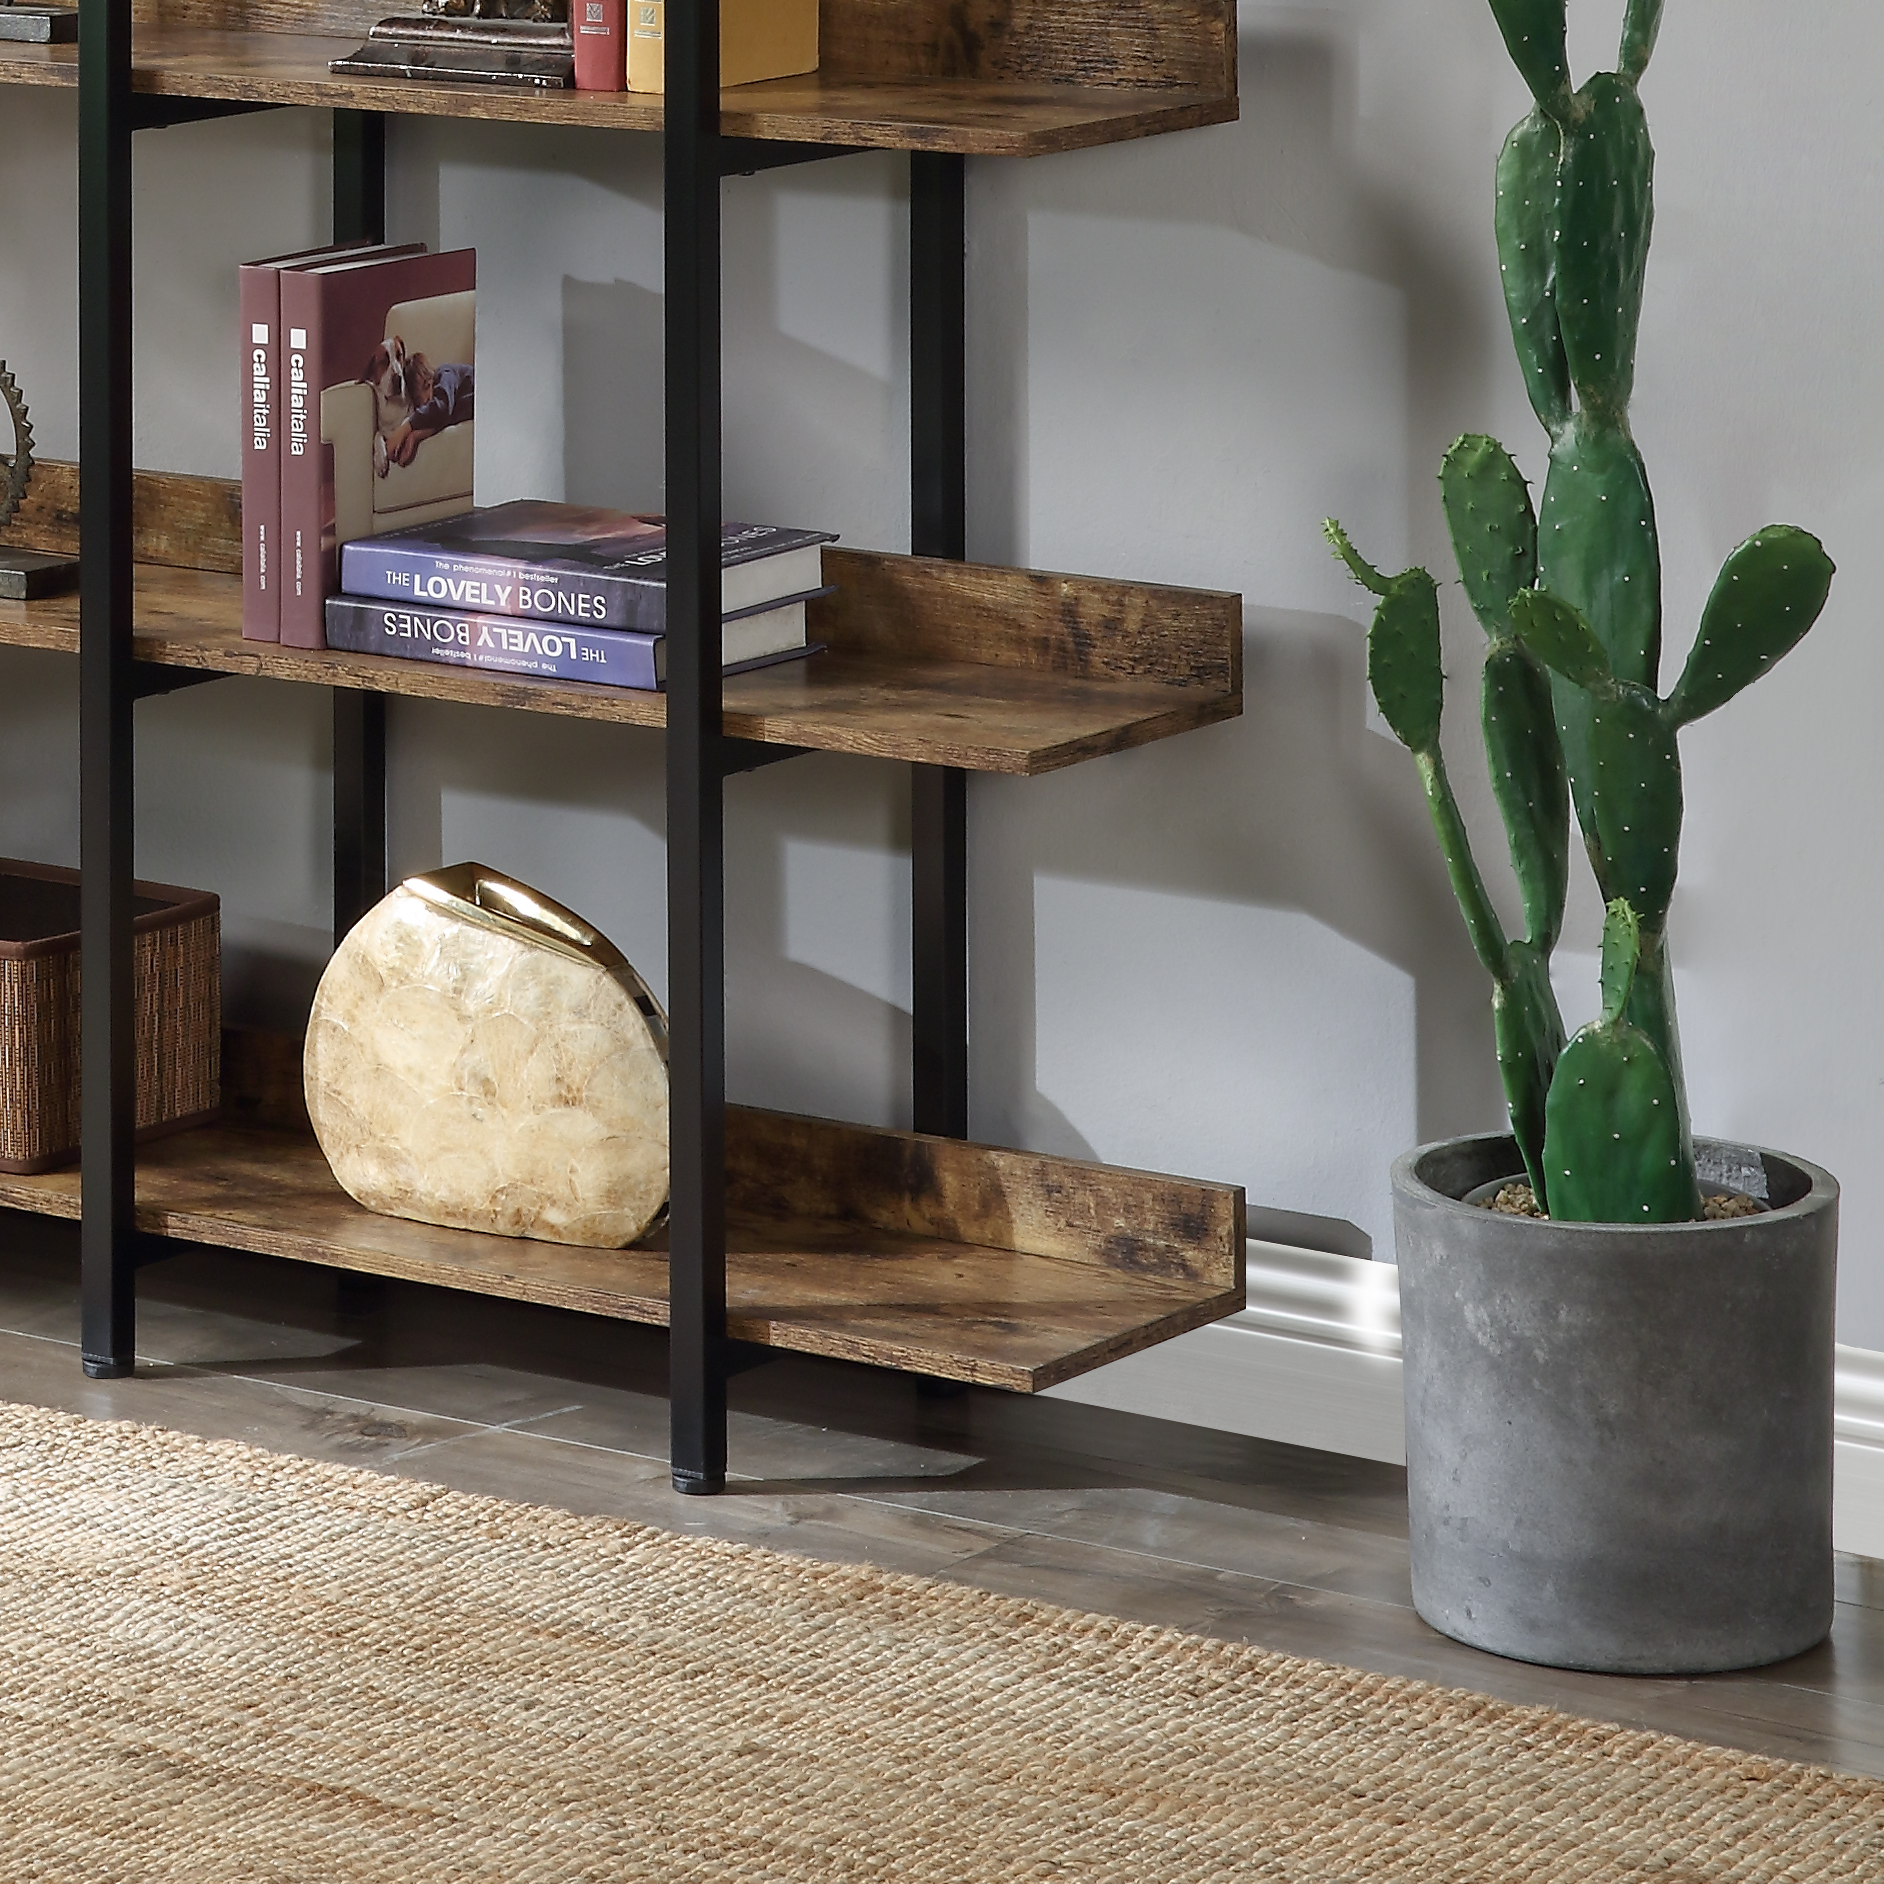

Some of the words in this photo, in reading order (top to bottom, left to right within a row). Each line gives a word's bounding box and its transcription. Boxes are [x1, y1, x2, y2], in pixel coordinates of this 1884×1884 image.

[252, 348, 270, 450] caliaitalia
[290, 353, 308, 456] caliaitalia
[385, 570, 410, 586] THE
[413, 574, 512, 607] LOVELY
[518, 586, 607, 620] BONES
[383, 612, 470, 646] BONES
[477, 626, 577, 660] LOVELY
[581, 647, 607, 664] THE
